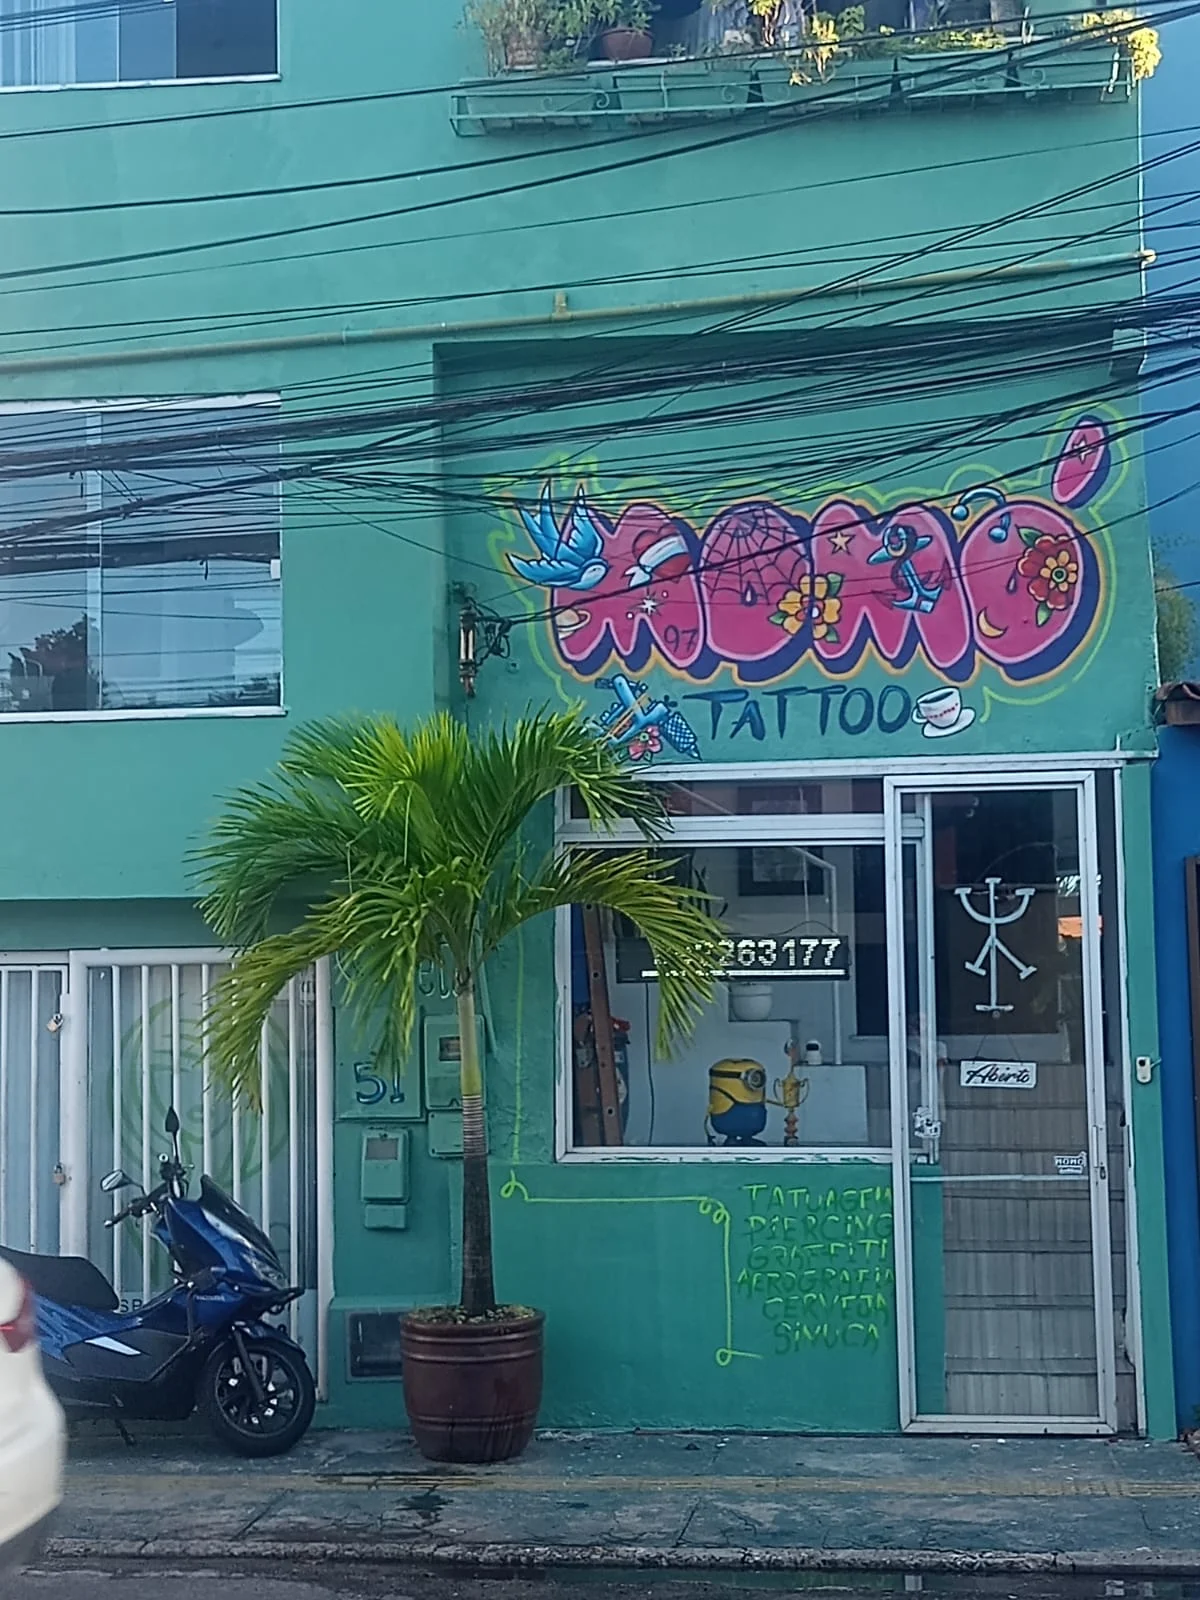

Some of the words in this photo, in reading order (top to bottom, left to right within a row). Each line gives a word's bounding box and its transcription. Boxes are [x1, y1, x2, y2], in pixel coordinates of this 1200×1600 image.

[663, 624, 699, 653] 97
[684, 685, 911, 740] TATTOO
[354, 1060, 405, 1104] 51
